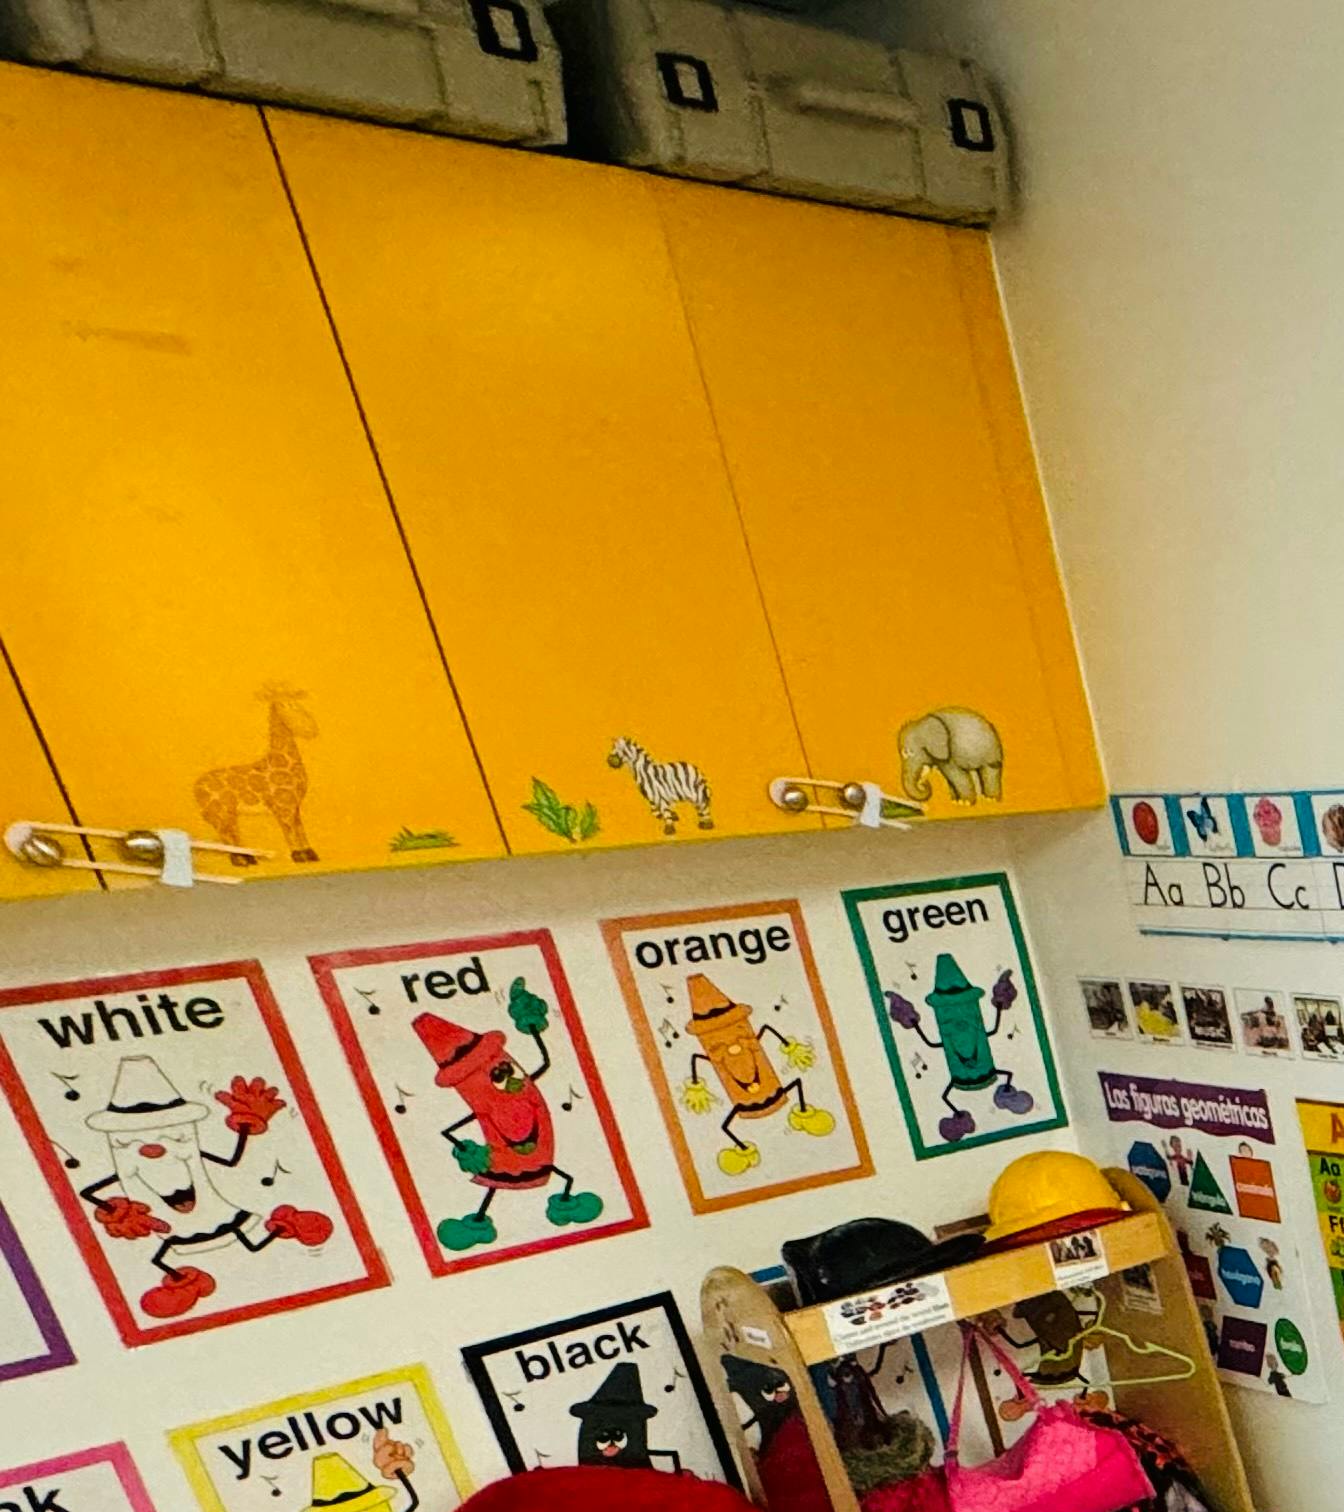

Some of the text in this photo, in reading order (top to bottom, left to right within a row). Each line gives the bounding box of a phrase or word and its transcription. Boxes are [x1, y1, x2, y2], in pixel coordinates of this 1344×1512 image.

[1143, 862, 1184, 907] Aa
[1203, 863, 1246, 908] Bb
[1267, 861, 1310, 911] Cc
[882, 894, 990, 942] green
[634, 922, 793, 970] orange
[400, 956, 489, 1003] red
[38, 992, 226, 1050] white
[1103, 1082, 1269, 1130] Las figuras geométricas
[1319, 1158, 1341, 1177] Aa
[515, 1320, 650, 1384] black
[218, 1396, 405, 1480] yellow
